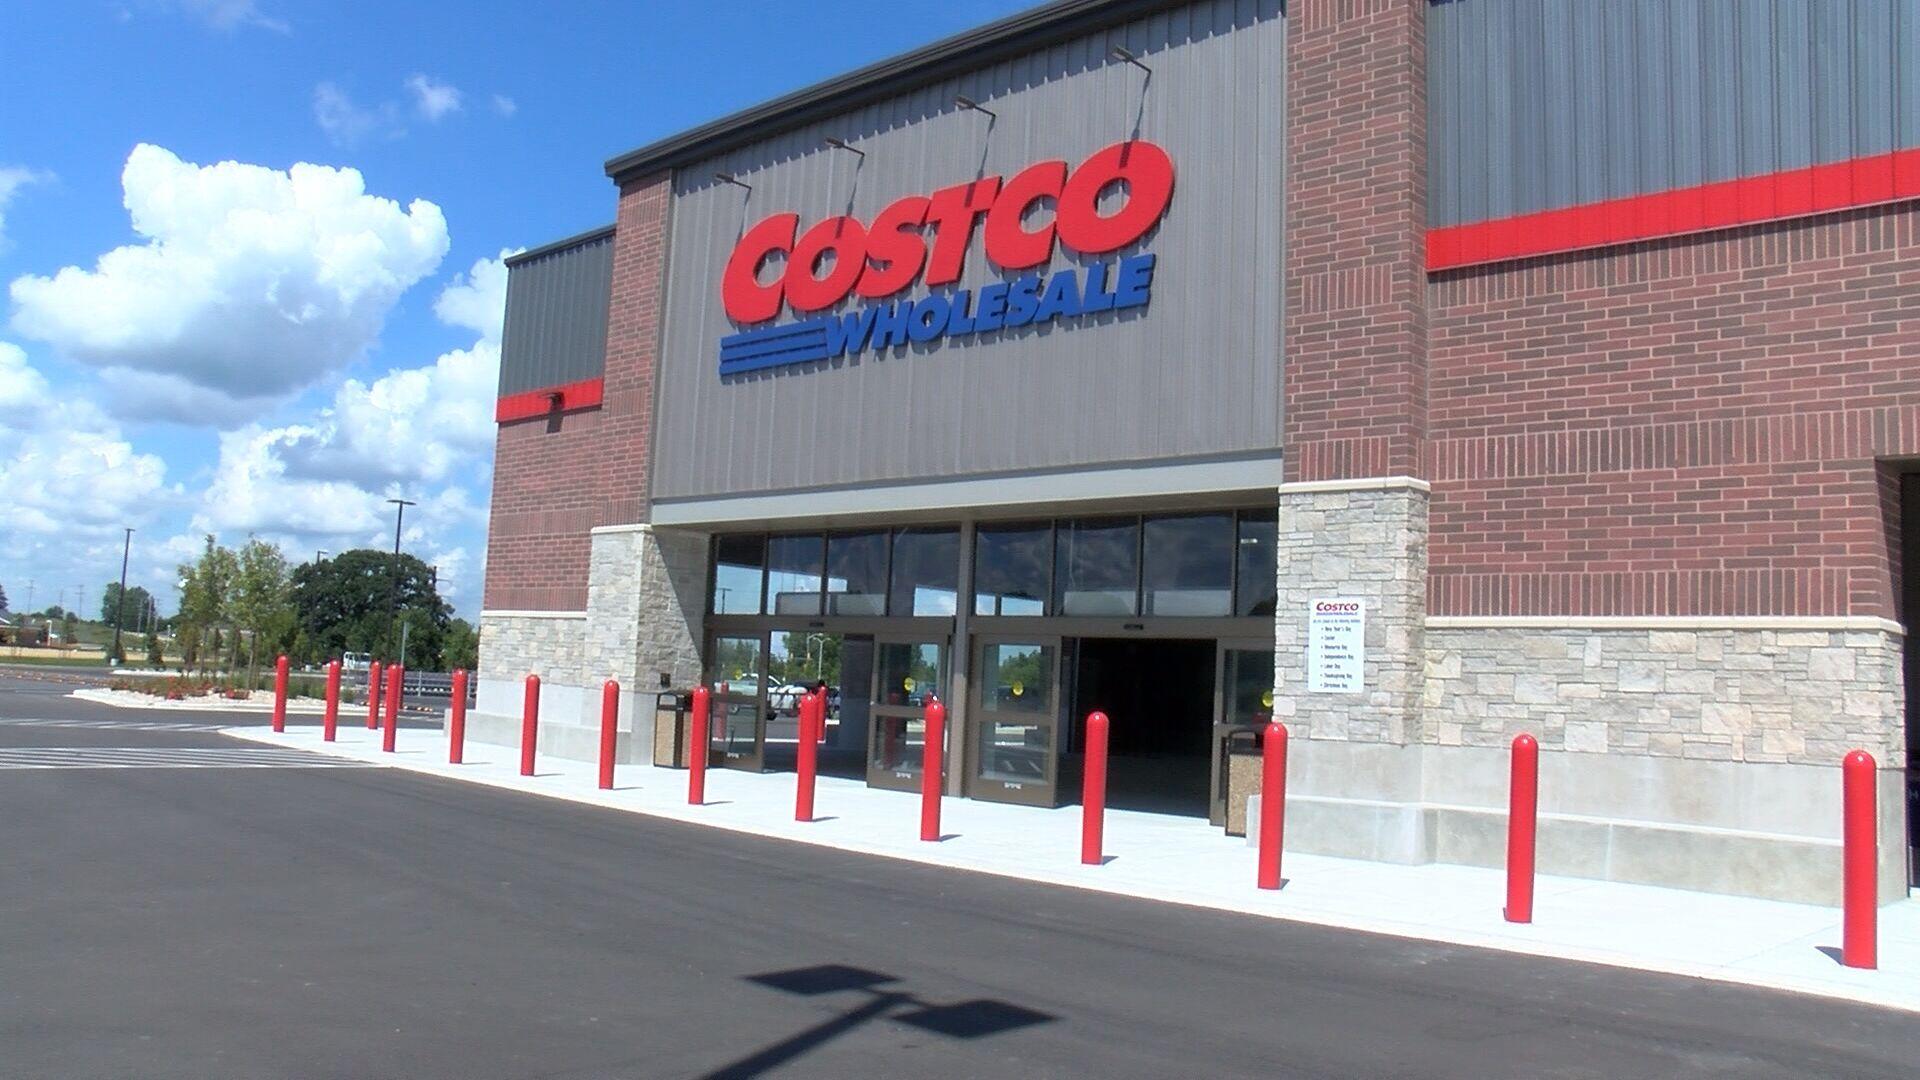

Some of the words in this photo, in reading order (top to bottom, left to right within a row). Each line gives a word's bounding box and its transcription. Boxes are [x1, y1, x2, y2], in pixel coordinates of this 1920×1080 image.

[721, 139, 1175, 324] COSTCO
[825, 254, 1157, 357] WHOLESALE
[1316, 601, 1359, 611] COSTCO
